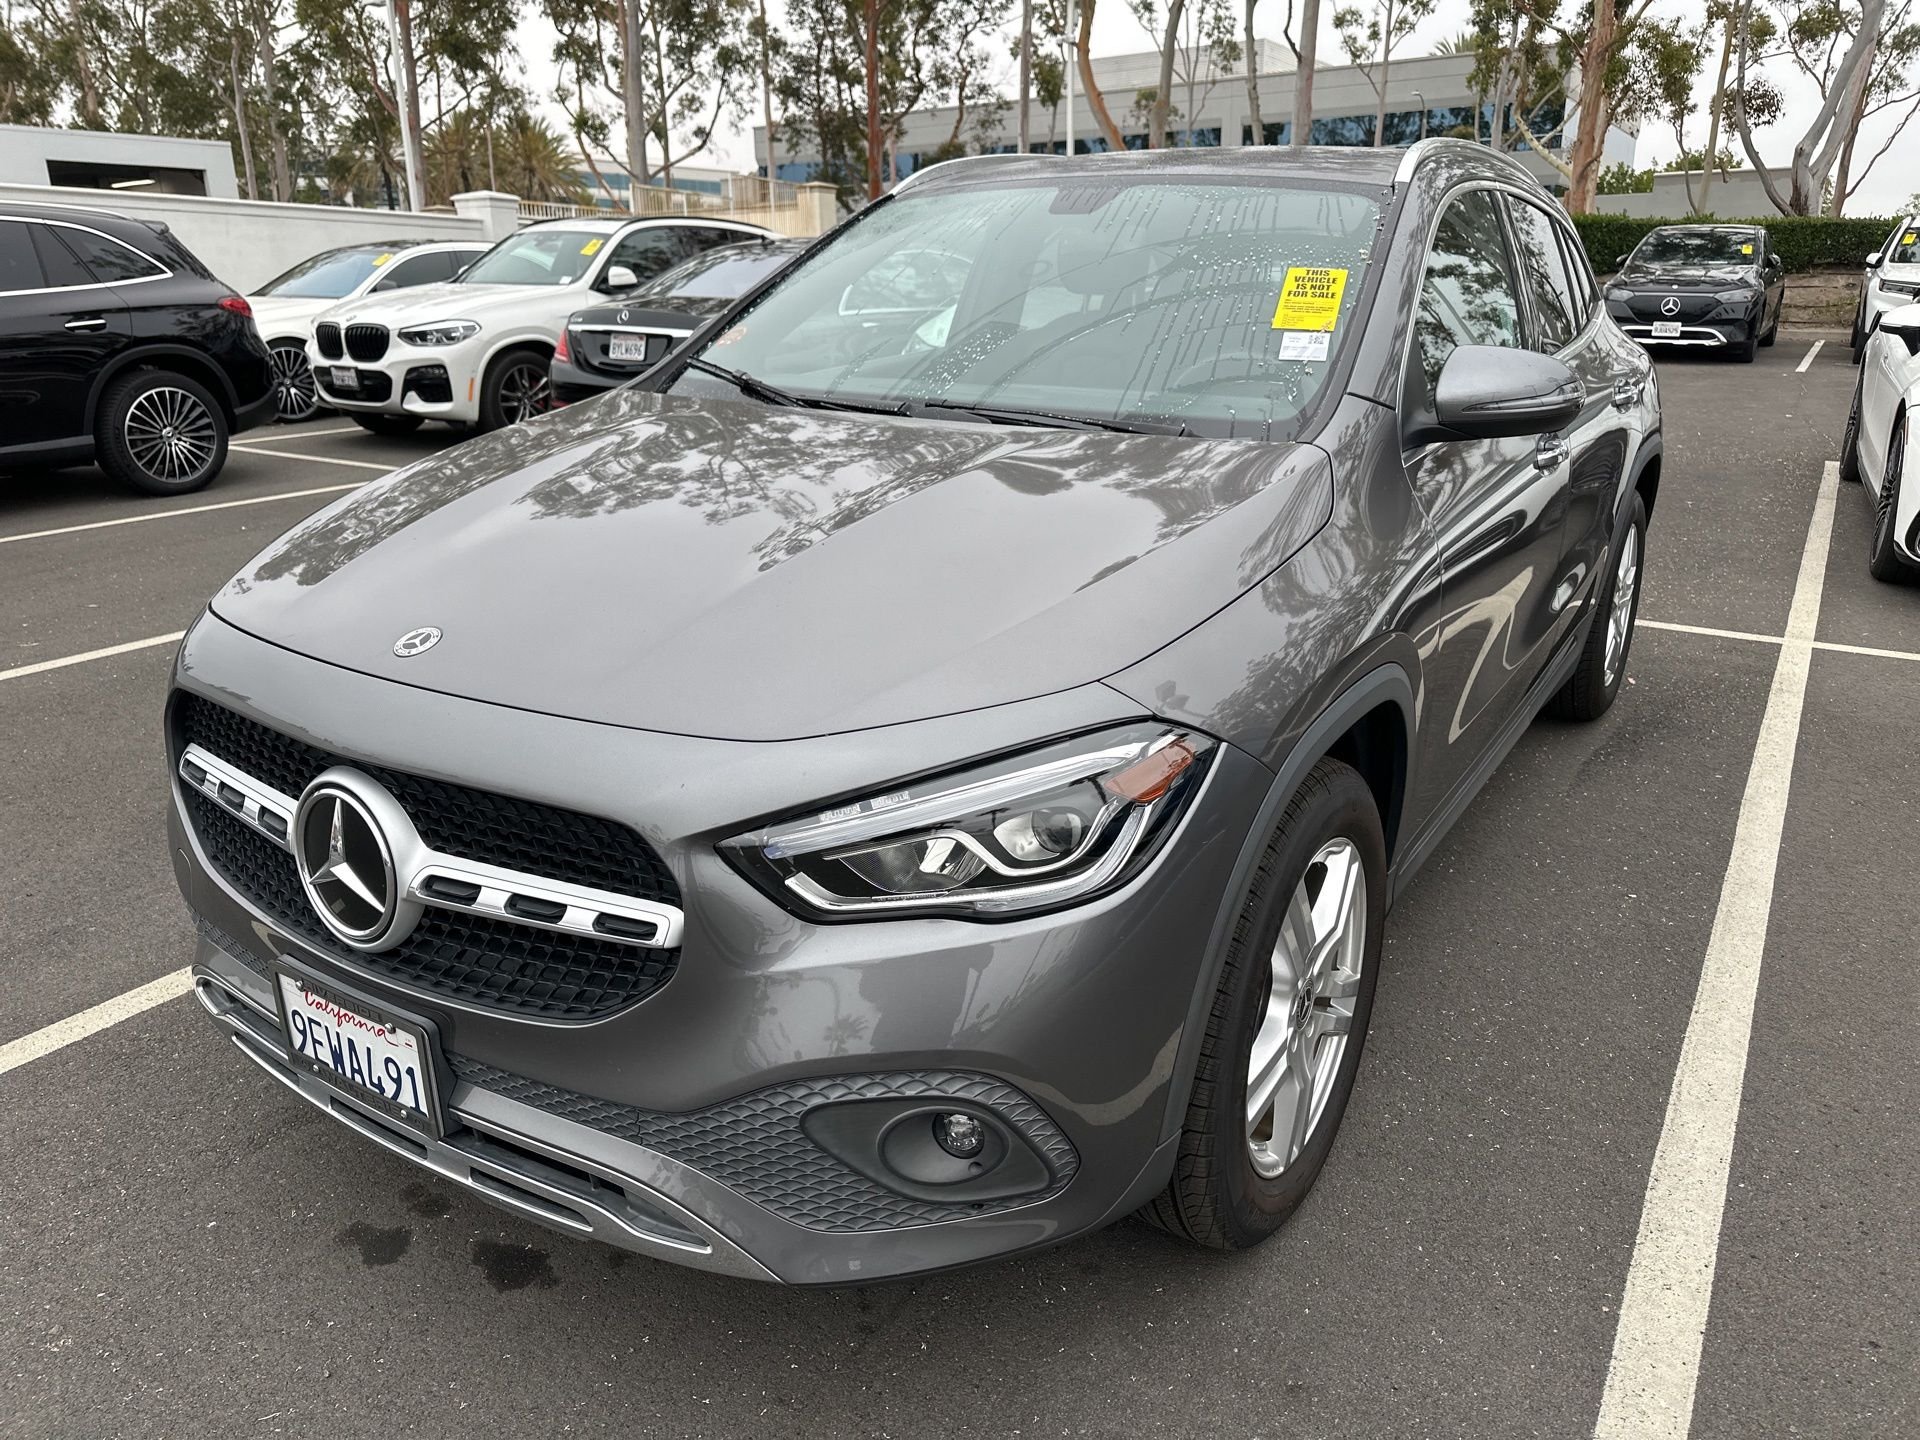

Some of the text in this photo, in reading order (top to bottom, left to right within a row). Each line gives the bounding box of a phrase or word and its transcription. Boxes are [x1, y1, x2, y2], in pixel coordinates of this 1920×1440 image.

[1294, 276, 1338, 284] VEHICLE
[1311, 291, 1336, 299] SALE
[304, 989, 398, 1046] California
[291, 1009, 428, 1118] 9EWA491
